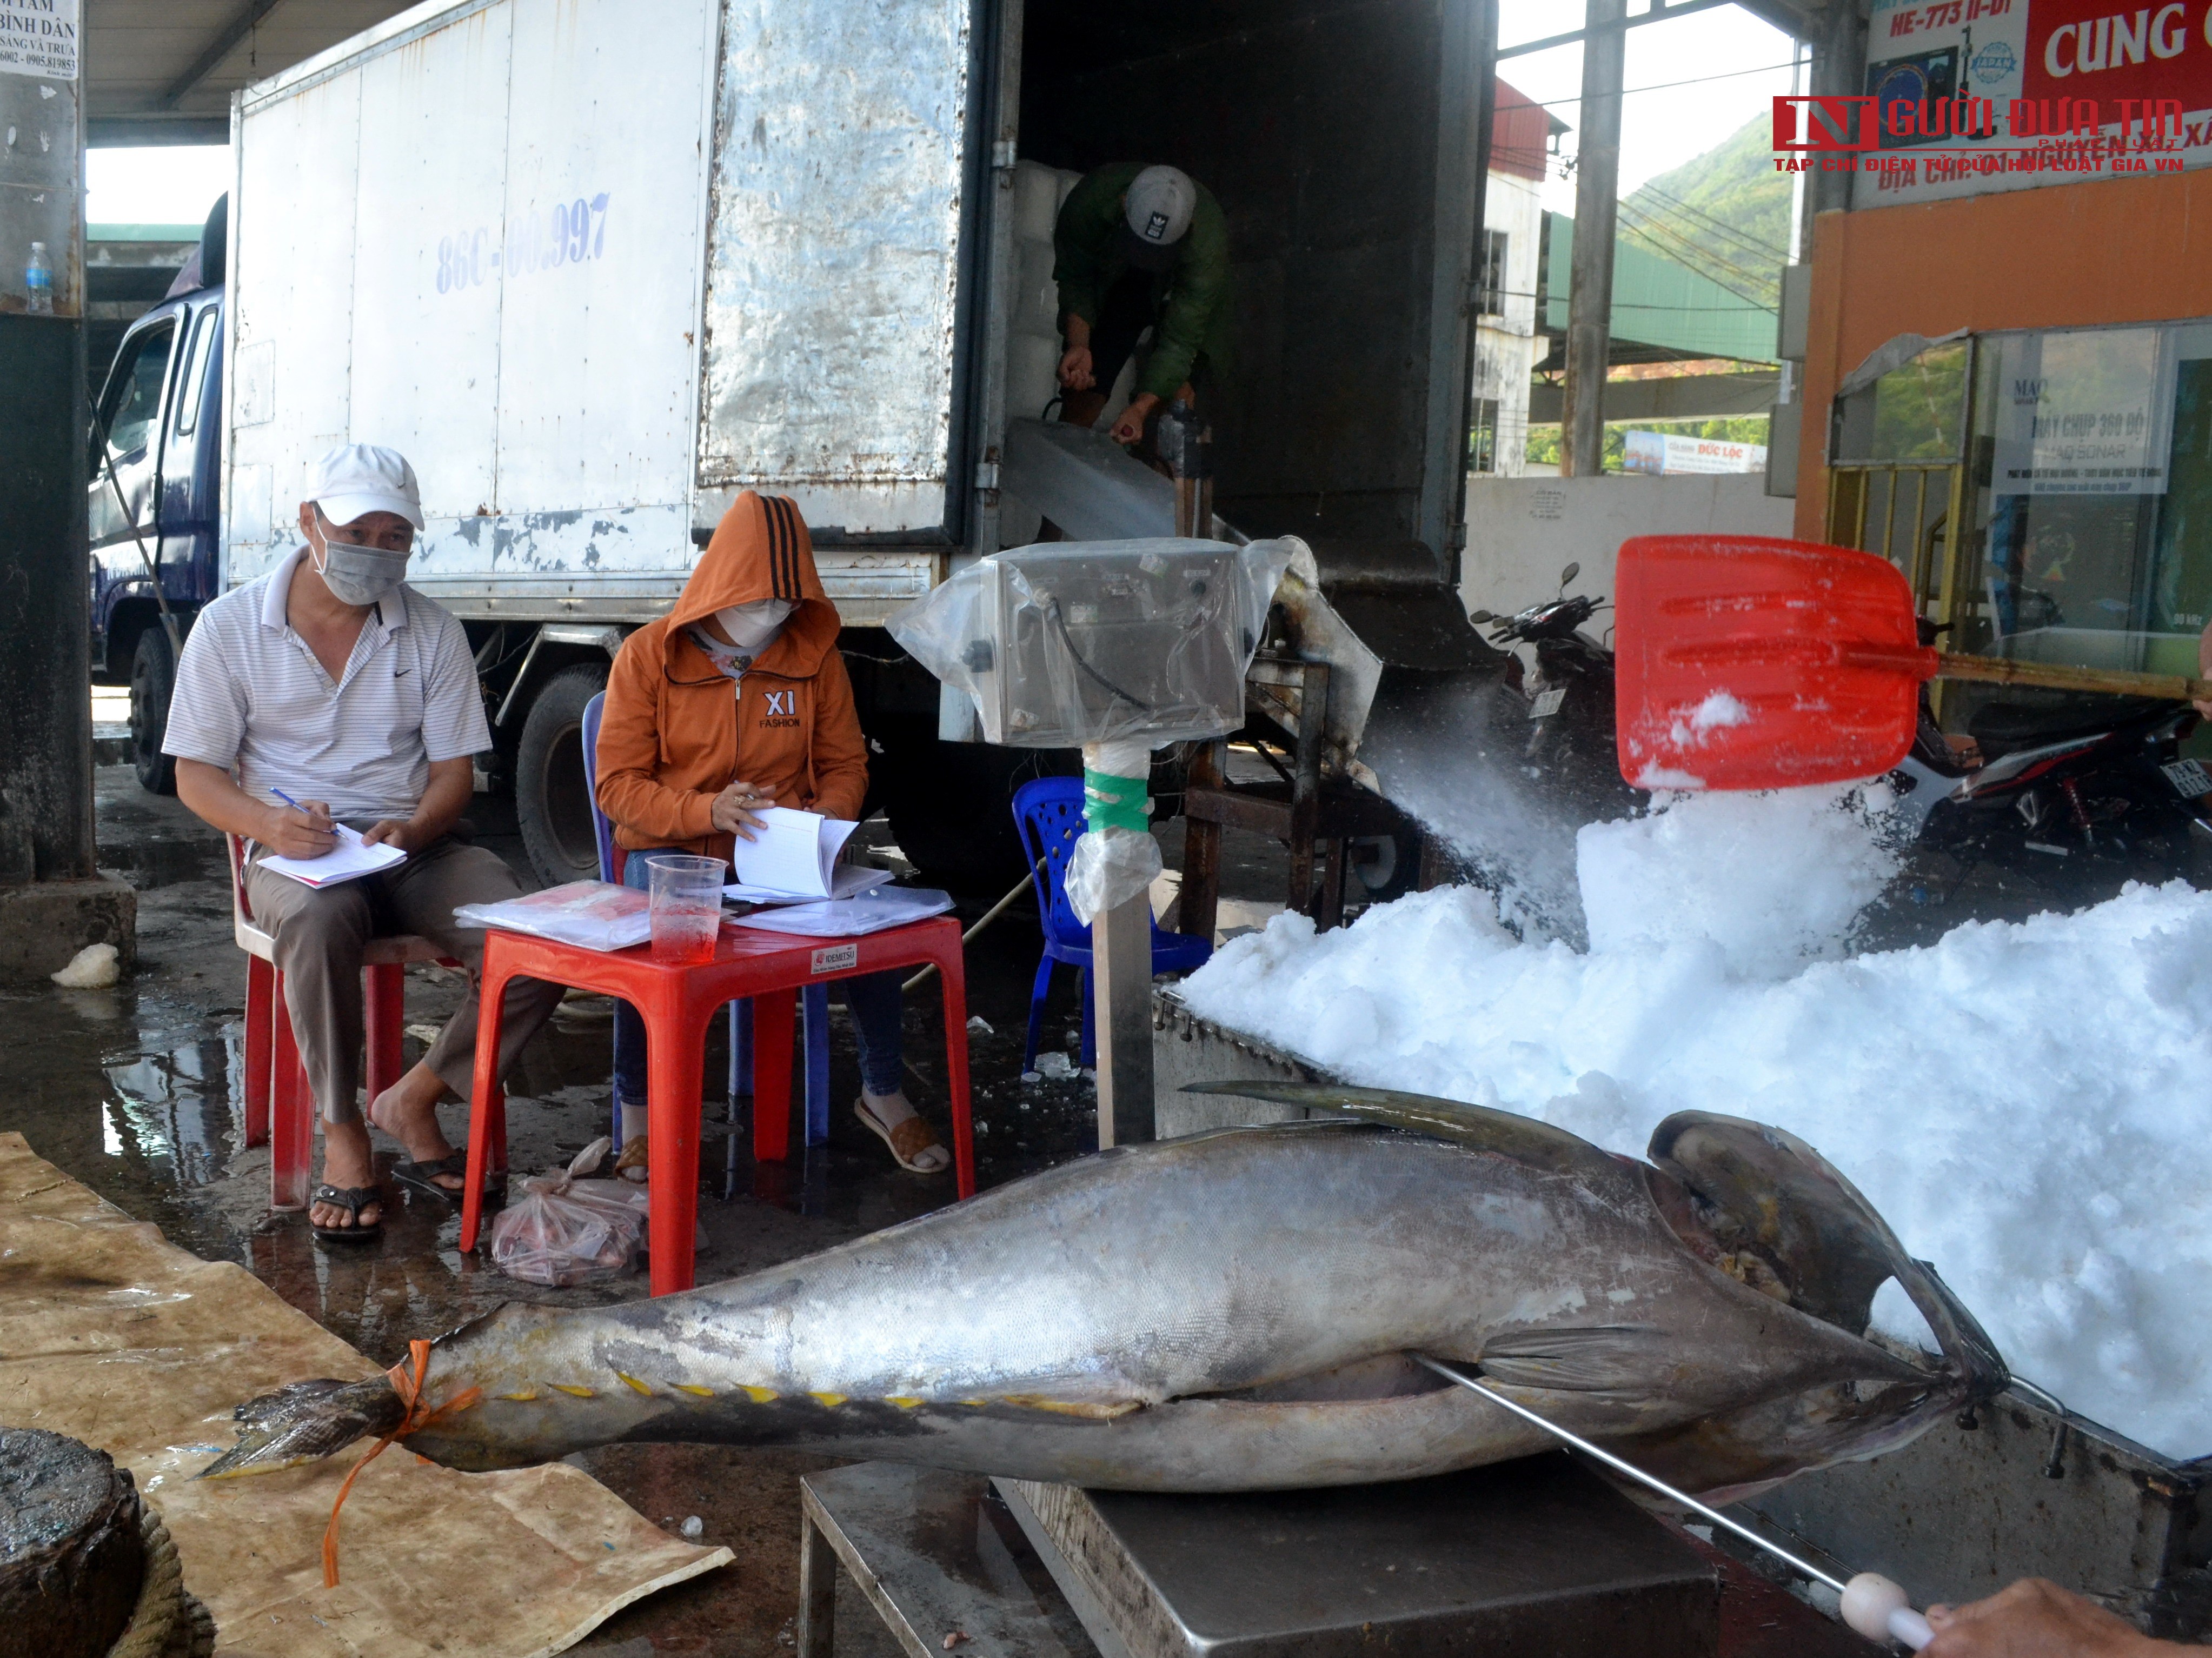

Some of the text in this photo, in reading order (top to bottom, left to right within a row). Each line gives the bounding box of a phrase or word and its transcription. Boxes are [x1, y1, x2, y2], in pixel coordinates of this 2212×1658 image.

[41, 17, 75, 38] DÂN
[1890, 1, 1963, 37] HE-773
[0, 34, 75, 56] SÁNG VÀ TRƯA
[2044, 3, 2187, 78] CUNG
[436, 191, 611, 295] 86C-00.997
[2099, 412, 2123, 437] 360
[1698, 441, 1721, 456] ĐỨC
[1722, 445, 1743, 459] LỘC
[2077, 444, 2126, 460] SONAR
[763, 689, 795, 716] XI
[759, 718, 800, 728] FASHION
[826, 950, 854, 963] IDEMITSU
